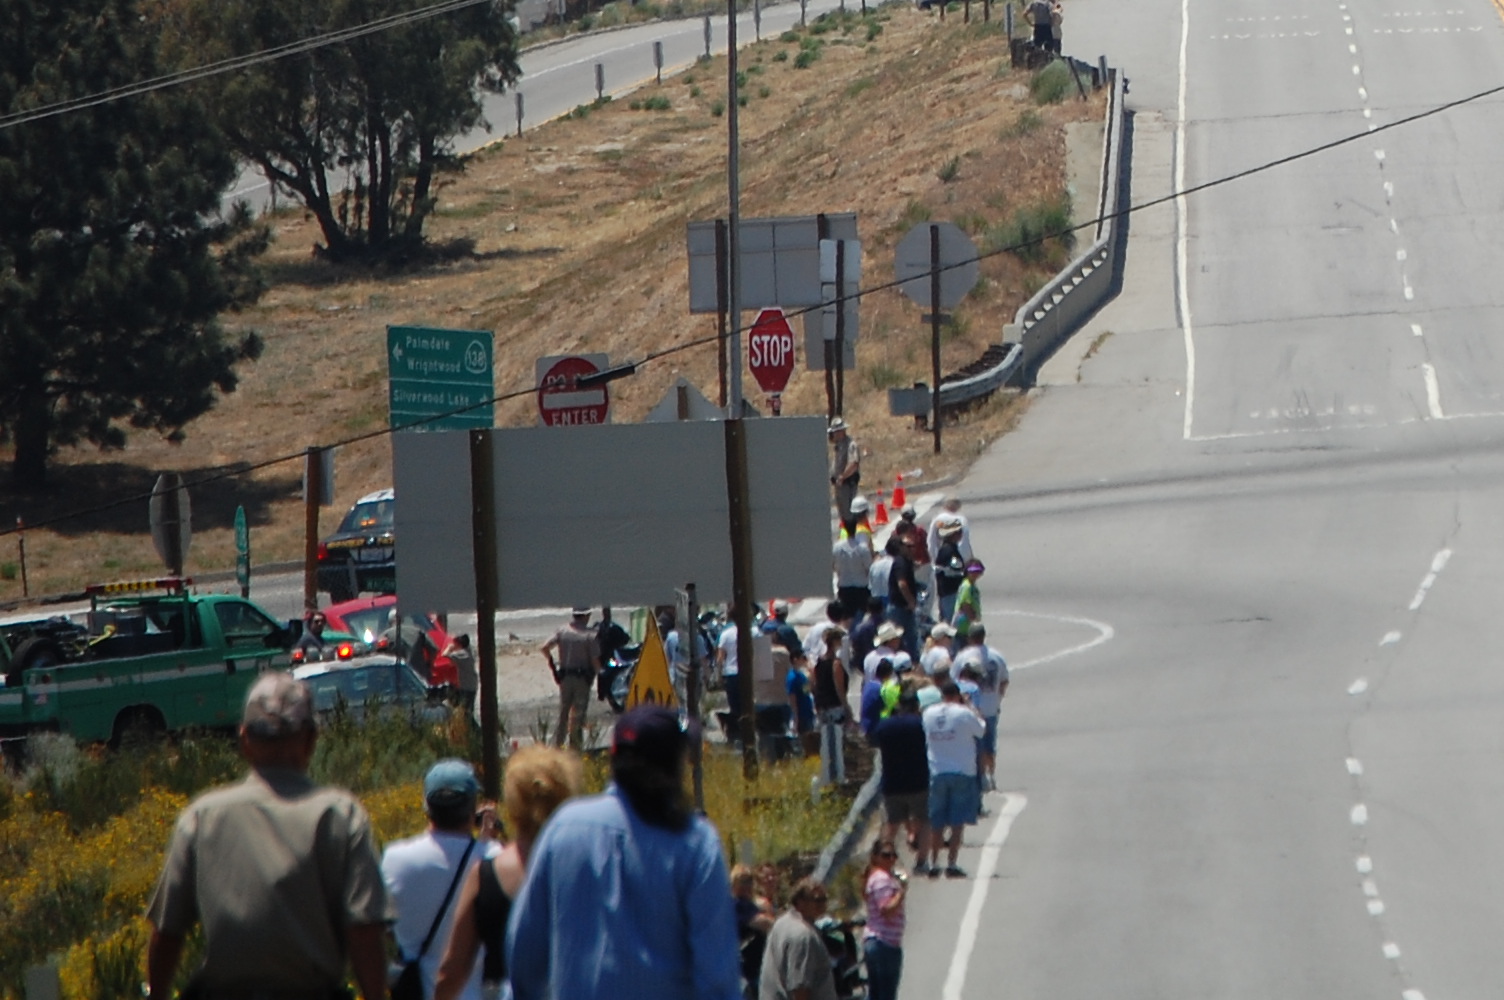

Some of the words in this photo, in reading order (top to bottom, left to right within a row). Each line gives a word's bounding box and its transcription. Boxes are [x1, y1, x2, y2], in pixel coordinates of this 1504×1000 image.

[406, 335, 451, 350] Palmdale
[467, 351, 485, 367] 138
[751, 335, 791, 367] STOP
[407, 358, 462, 375] Wrightwood
[393, 389, 445, 405] Silverwood
[551, 411, 599, 426] ENTER
